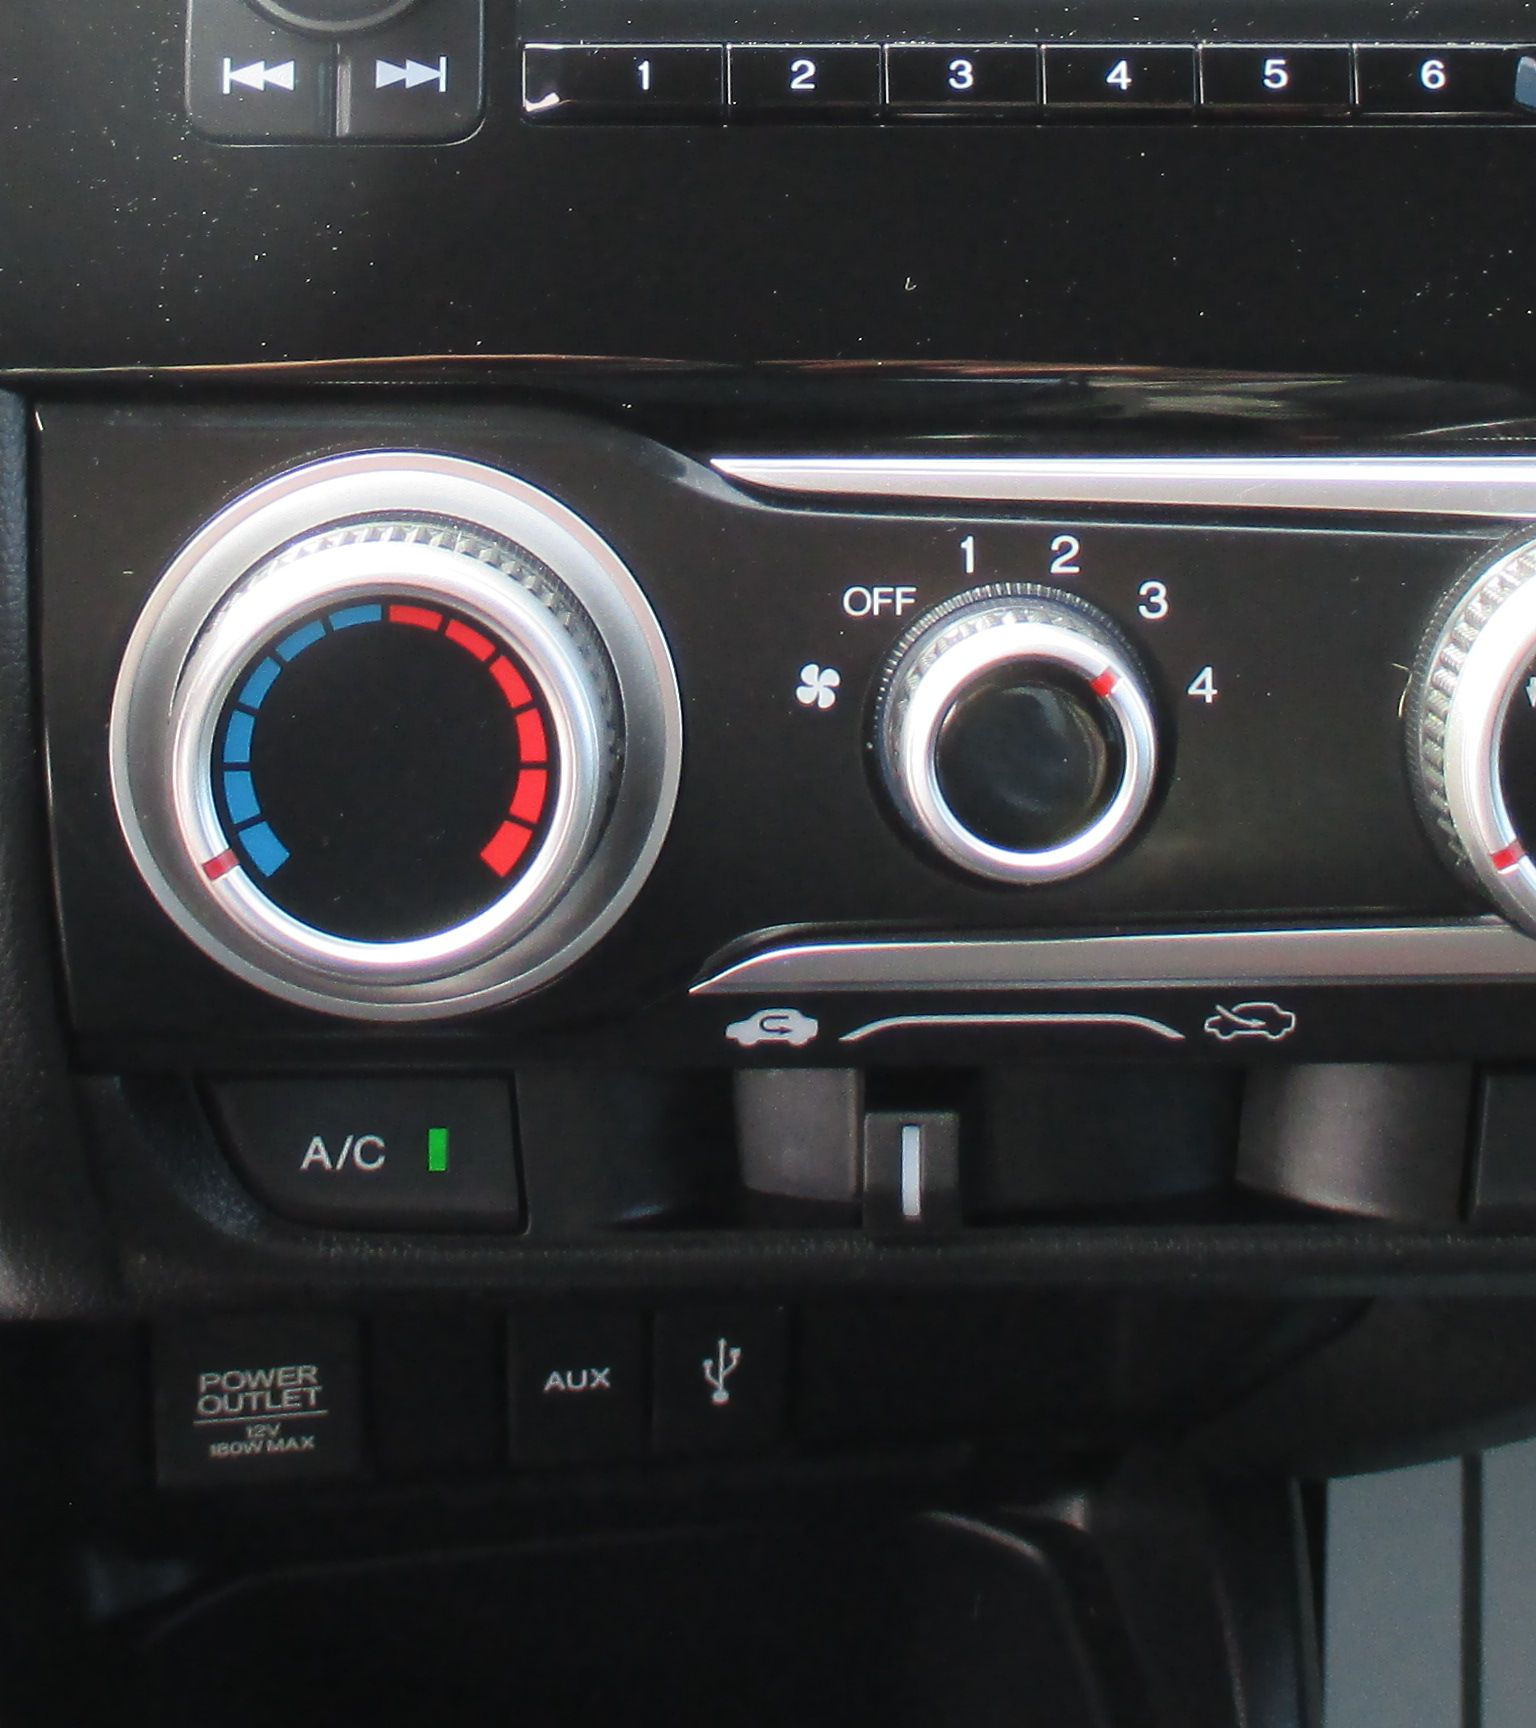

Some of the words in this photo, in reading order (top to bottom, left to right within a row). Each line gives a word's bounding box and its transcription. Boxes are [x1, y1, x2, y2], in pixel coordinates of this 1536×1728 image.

[637, 59, 650, 91] 1
[790, 59, 816, 90] 2
[948, 58, 974, 90] 3
[1106, 59, 1132, 91] 4
[1263, 58, 1289, 89] 5
[1420, 59, 1446, 90] 6
[960, 535, 975, 574] 1
[1050, 534, 1080, 575] 2
[843, 586, 917, 617] OFF
[1138, 580, 1169, 620] 3
[1187, 666, 1218, 704] 4
[300, 1134, 386, 1170] A/C
[198, 1364, 319, 1393] POWER
[544, 1367, 611, 1392] AUX
[196, 1384, 323, 1415] OUTLET
[246, 1422, 280, 1440] 12V
[266, 1434, 316, 1453] MAX
